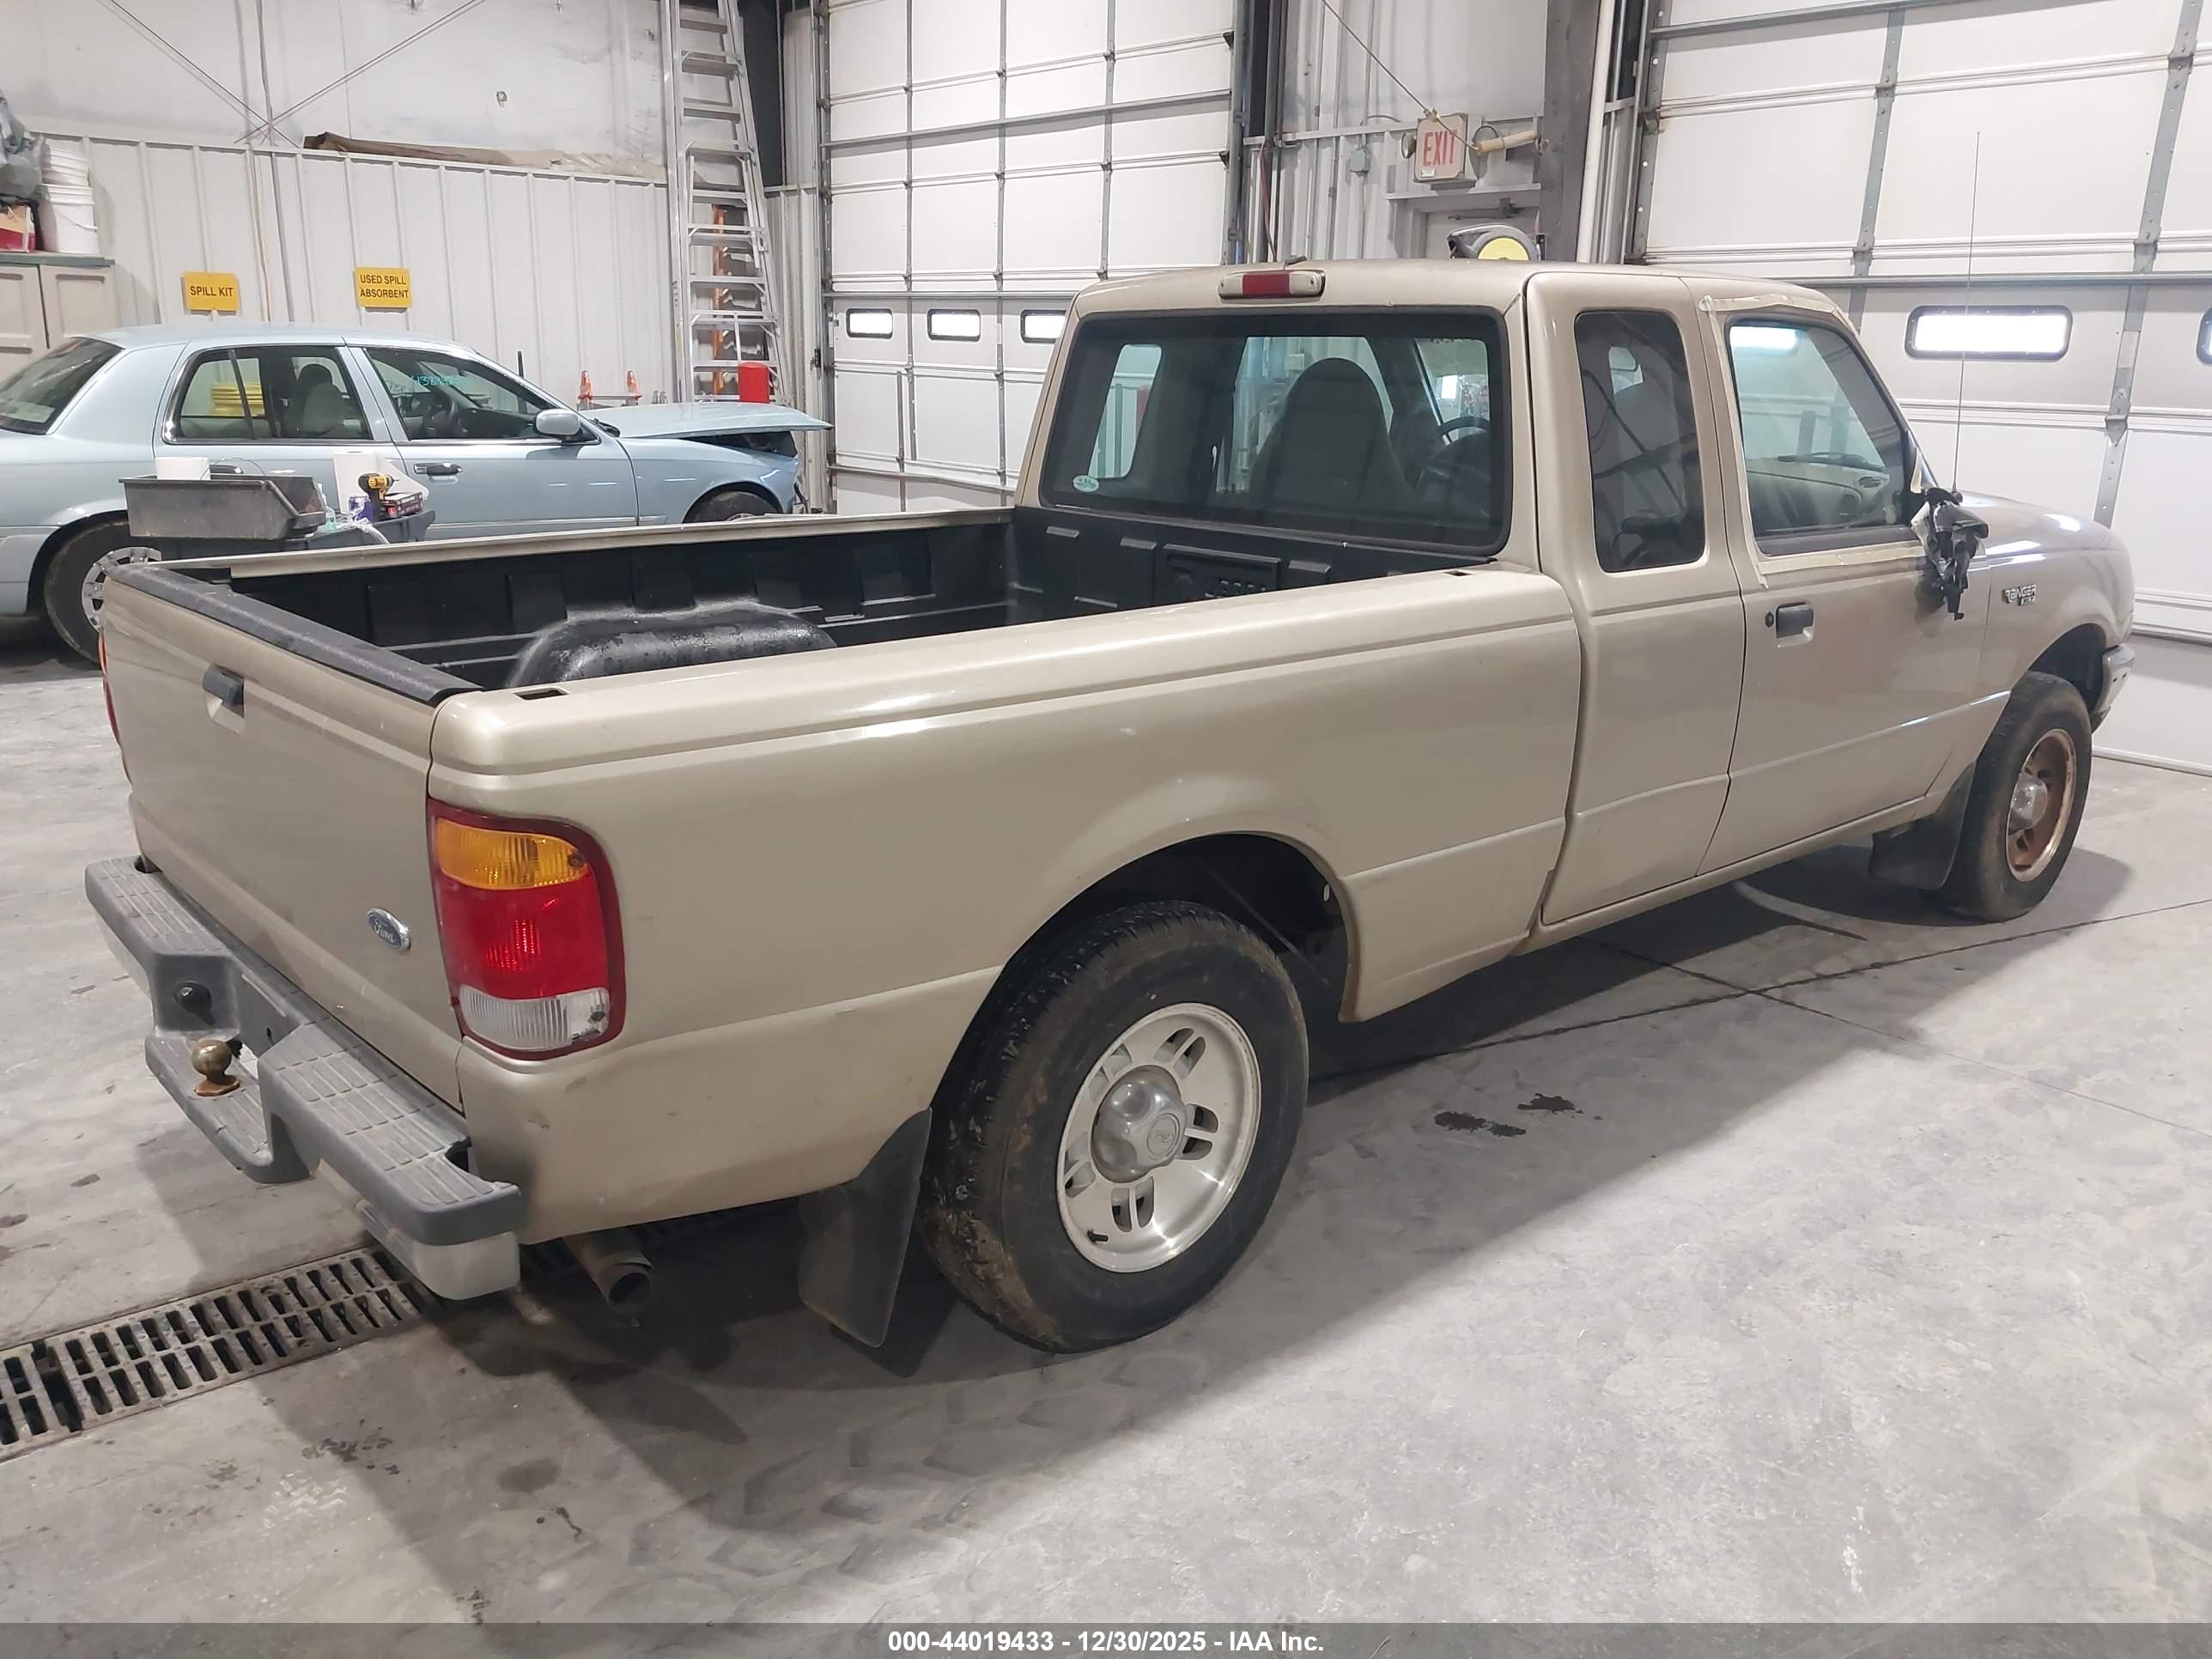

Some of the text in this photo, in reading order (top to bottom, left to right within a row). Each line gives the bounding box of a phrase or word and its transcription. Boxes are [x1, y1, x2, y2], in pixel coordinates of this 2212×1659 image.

[1422, 130, 1457, 167] EXIT
[360, 274, 406, 285] USED SPILL
[190, 285, 234, 297] SPILL KIT
[360, 288, 409, 299] ABSORBENT
